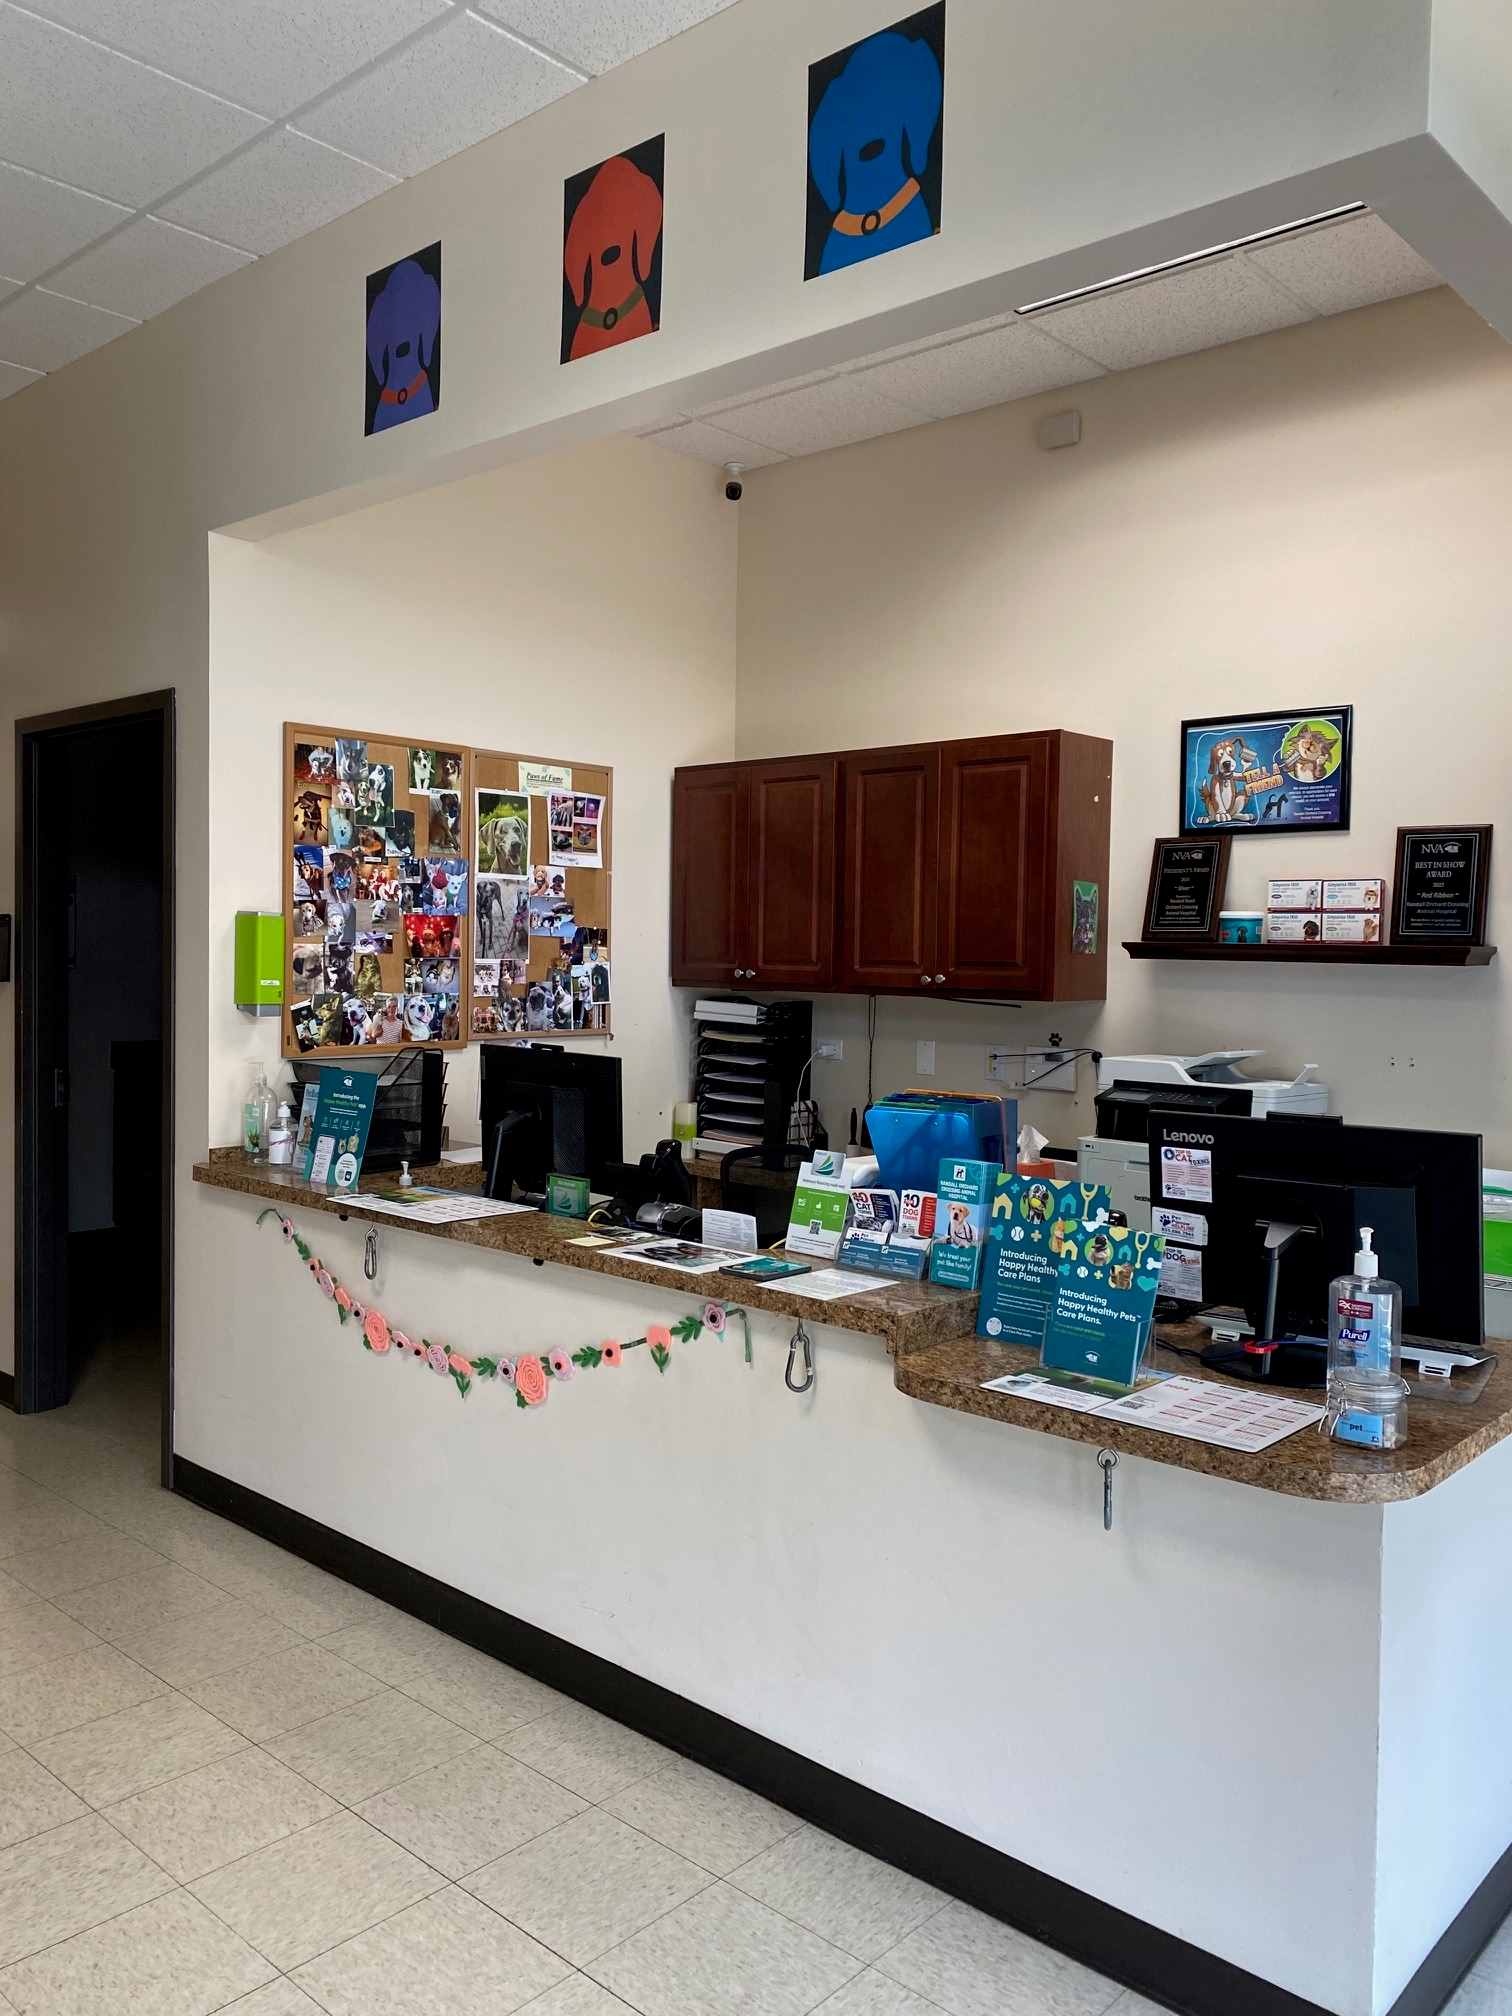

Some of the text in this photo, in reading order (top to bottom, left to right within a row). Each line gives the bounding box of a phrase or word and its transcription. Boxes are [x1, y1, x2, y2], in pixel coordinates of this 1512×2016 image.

[1172, 851, 1191, 860] NVA
[1421, 844, 1444, 853] NVA
[1415, 861, 1466, 869] BEST IN SHOW
[1162, 1128, 1215, 1145] Lenovo
[1175, 1153, 1192, 1162] CAT
[856, 1203, 871, 1211] CAT
[903, 1193, 920, 1208] 10
[903, 1208, 919, 1216] DOG
[1000, 1248, 1048, 1266] Introducing
[1166, 1253, 1186, 1263] DOG
[999, 1258, 1058, 1277] Happy Healthy
[997, 1268, 1041, 1283] Care Plans
[1059, 1287, 1108, 1306] Introducing
[1057, 1297, 1085, 1311] Happy
[1086, 1304, 1119, 1319] Healthy
[1056, 1308, 1102, 1325] Care Plans.
